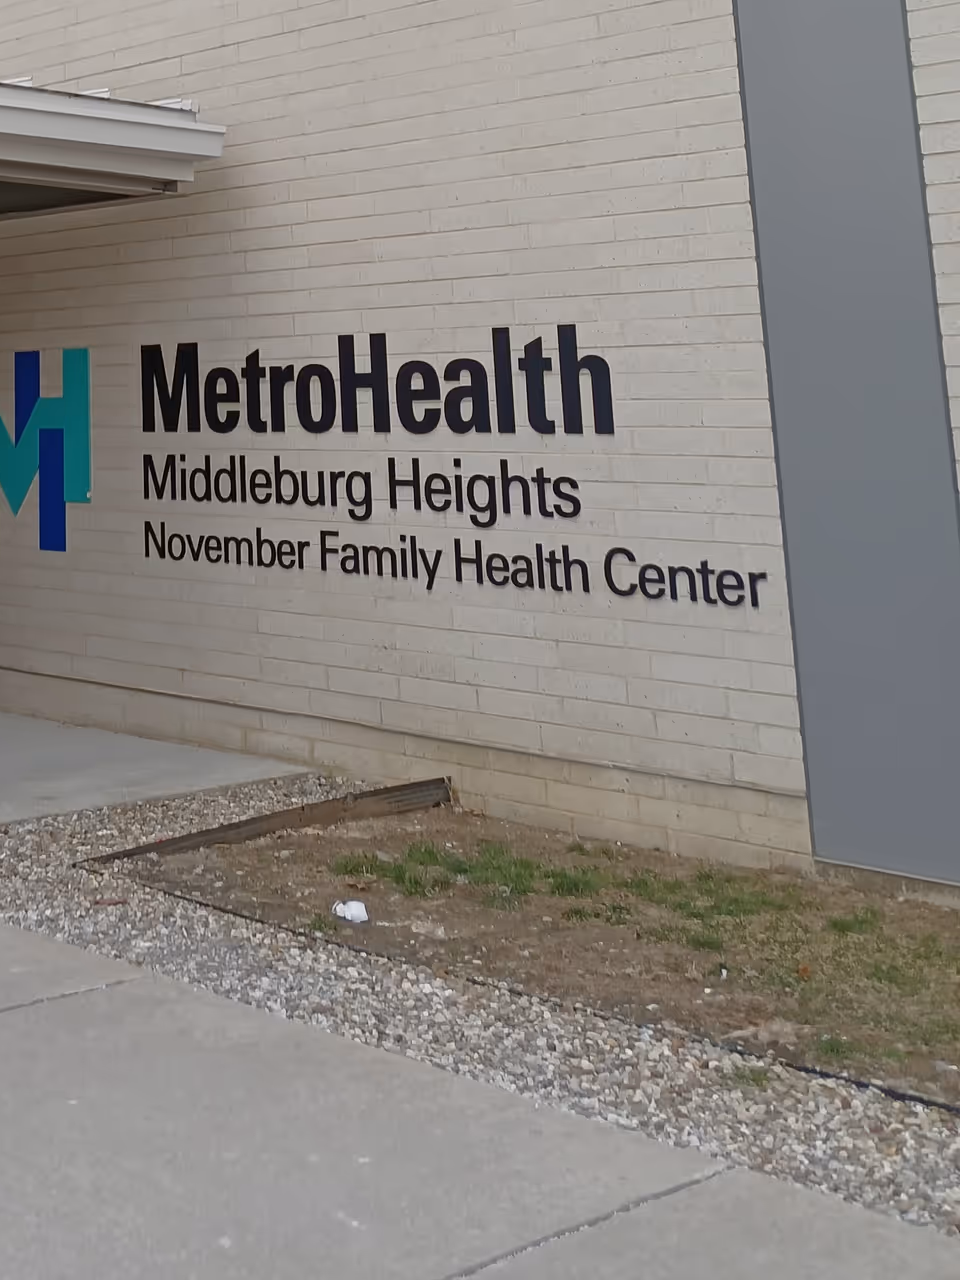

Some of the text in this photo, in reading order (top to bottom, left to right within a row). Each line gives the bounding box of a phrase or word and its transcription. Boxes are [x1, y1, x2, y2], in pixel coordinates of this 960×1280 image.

[140, 323, 615, 436] MetroHealth
[142, 453, 582, 529] Middleburg Heights
[143, 520, 768, 608] November Family Health Center
